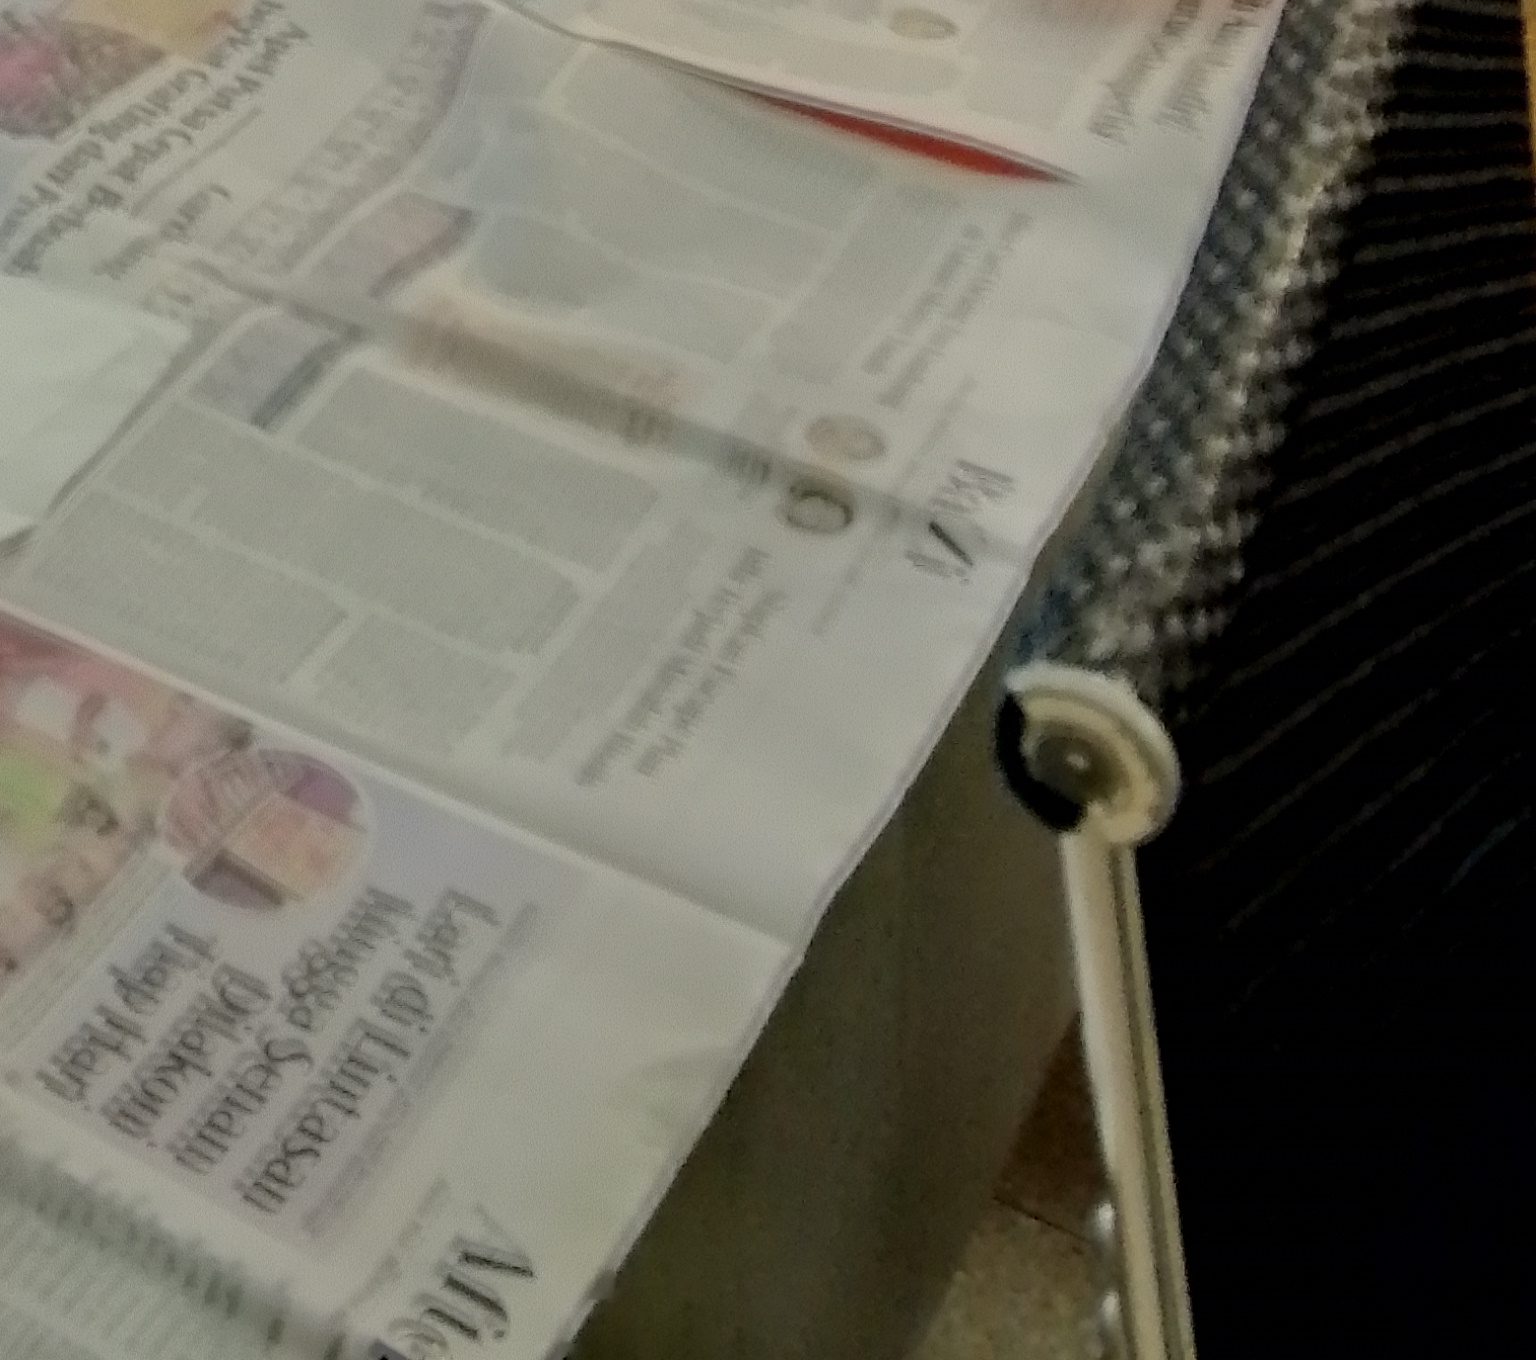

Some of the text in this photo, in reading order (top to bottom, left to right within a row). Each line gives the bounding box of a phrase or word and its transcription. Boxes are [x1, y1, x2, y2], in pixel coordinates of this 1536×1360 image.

[37, 922, 217, 1110] Tiap Hari
[371, 970, 434, 1034] di
[403, 886, 500, 986] Lari
[101, 963, 270, 1148] Dilakoni
[167, 1037, 312, 1176] Senam
[234, 1017, 411, 1215] Lintasan
